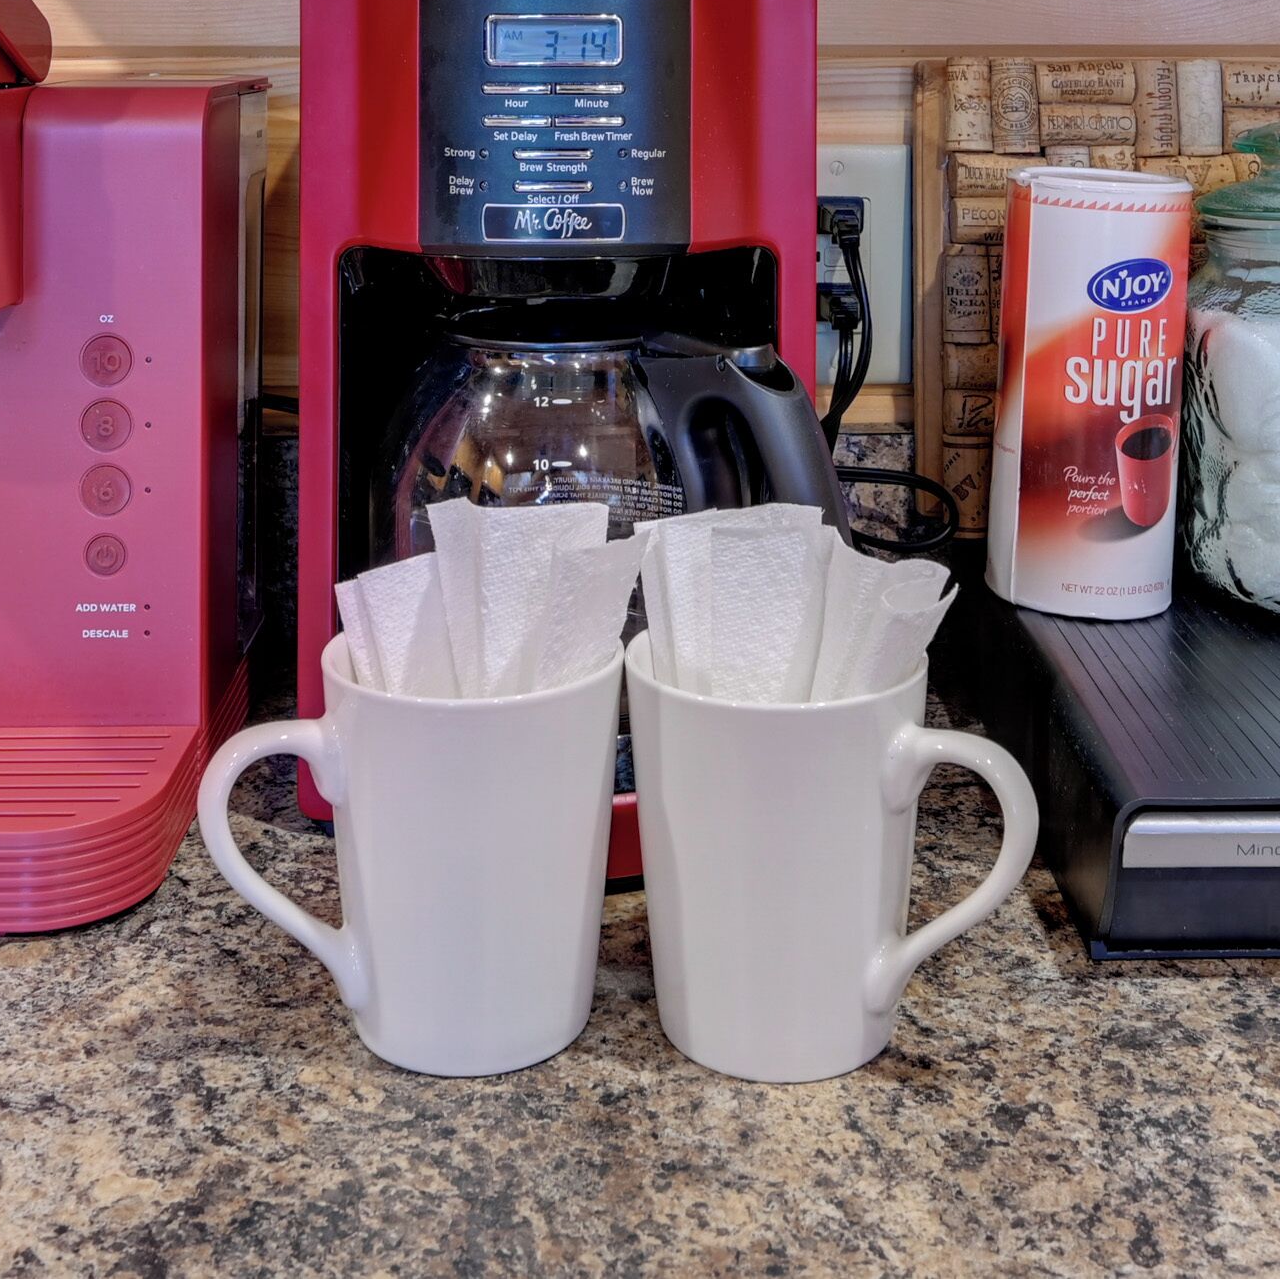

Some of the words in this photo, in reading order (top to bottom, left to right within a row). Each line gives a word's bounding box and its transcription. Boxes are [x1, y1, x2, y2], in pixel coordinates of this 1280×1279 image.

[543, 30, 608, 61] 3:14
[505, 99, 529, 108] Hour
[574, 99, 609, 108] Minute
[493, 132, 509, 141] Set
[511, 132, 538, 143] Delay
[554, 131, 581, 141] Fresh
[581, 132, 605, 142] Brew
[605, 132, 633, 142] Timer
[444, 147, 476, 160] Strong
[631, 149, 667, 160] Regular
[520, 163, 543, 172] Brew
[546, 163, 588, 175] Strength
[448, 176, 475, 187] Delay
[631, 177, 654, 186] Brew
[449, 186, 474, 195] Brew
[631, 187, 653, 196] Now
[527, 195, 556, 204] Select
[563, 195, 580, 204] Off
[514, 210, 542, 234] Mr.
[543, 208, 593, 239] Coffee
[946, 286, 989, 297] BELLA
[950, 297, 986, 307] SERA
[1120, 297, 1153, 307] BRAND
[99, 314, 115, 323] OZ
[1091, 317, 1168, 358] PURE
[93, 350, 122, 372] 10
[1064, 356, 1178, 424] sugar
[533, 396, 550, 408] 12
[98, 416, 114, 437] 8
[533, 459, 550, 471] 10
[1063, 465, 1096, 484] Pours
[1098, 471, 1116, 486] the
[97, 480, 114, 503] 6
[1067, 485, 1110, 503] perfect
[1066, 503, 1108, 517] portion
[1061, 582, 1078, 593] NET
[1079, 584, 1094, 594] WT
[1095, 586, 1106, 596] 22
[1106, 586, 1119, 596] OZ
[1127, 585, 1138, 595] LB
[75, 603, 98, 613] ADD
[99, 603, 137, 613] WATER
[82, 629, 129, 638] DESCALE
